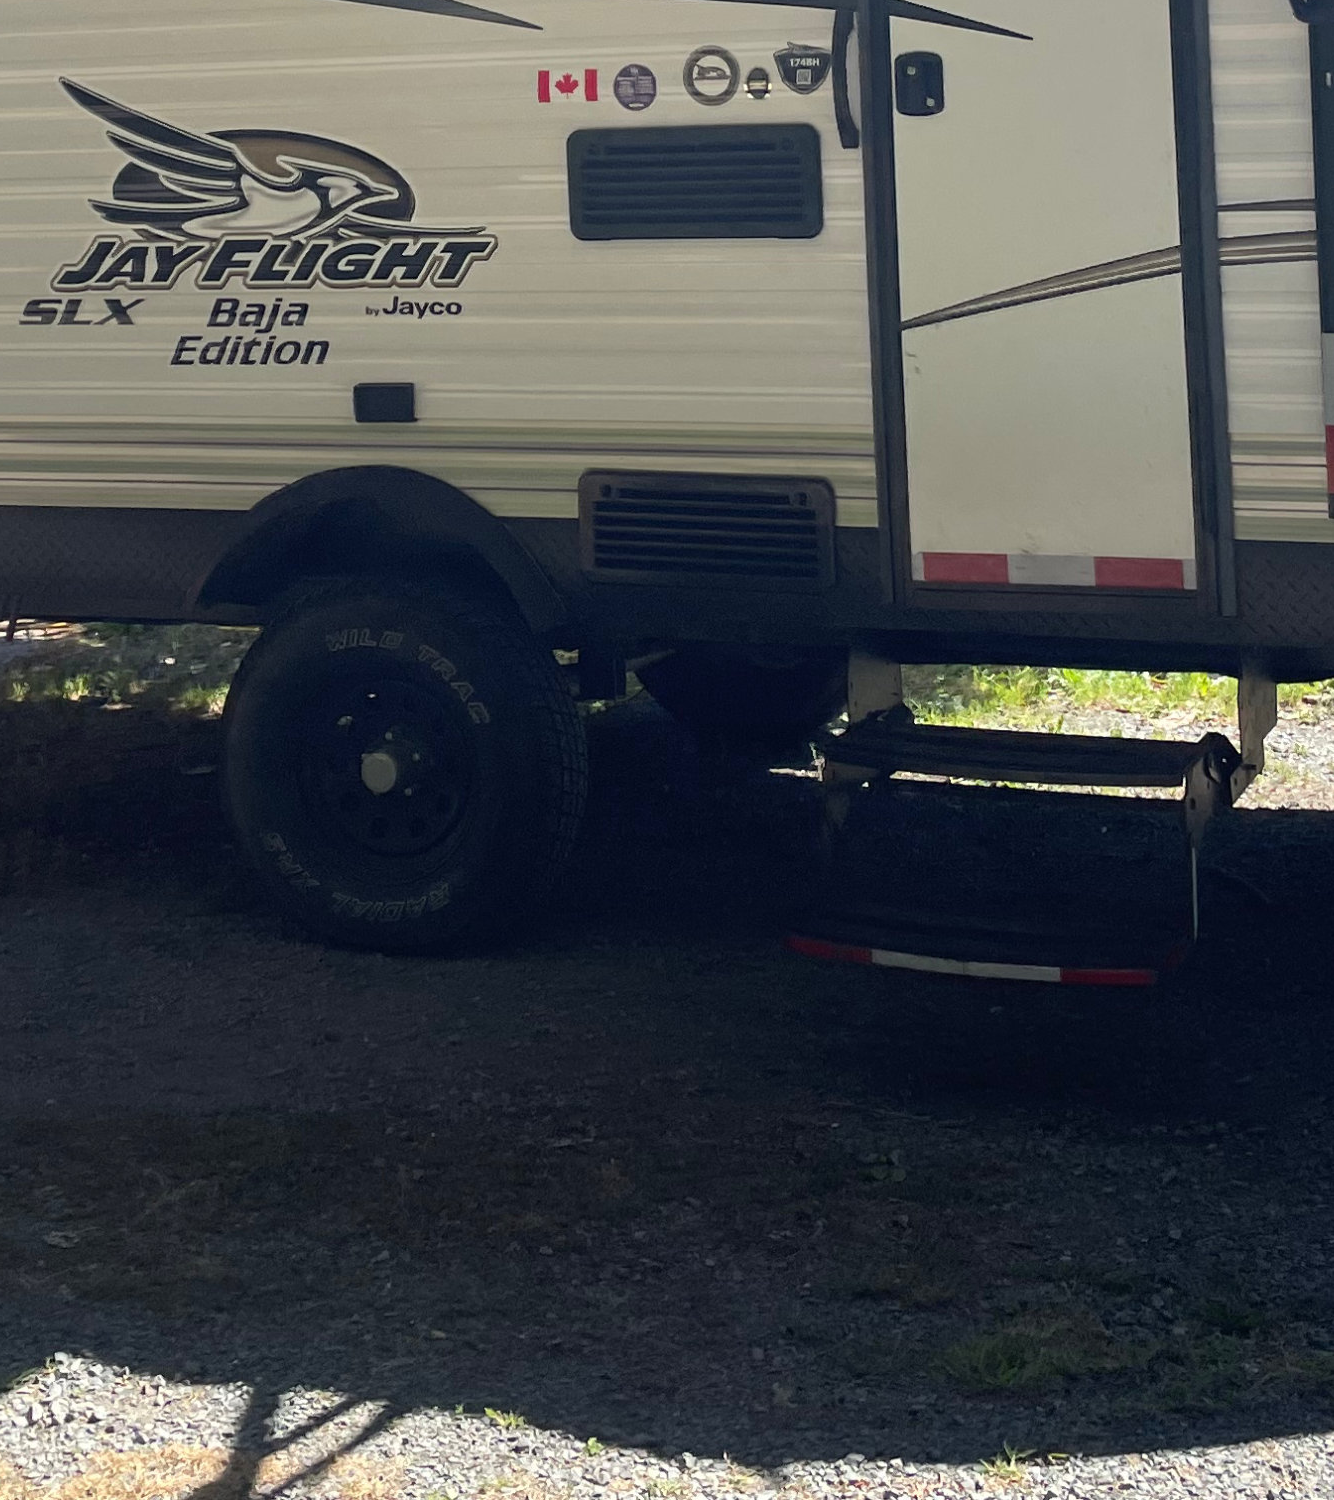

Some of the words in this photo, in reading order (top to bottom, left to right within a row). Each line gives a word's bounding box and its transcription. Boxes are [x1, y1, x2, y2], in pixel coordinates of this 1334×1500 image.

[789, 57, 820, 68] 174BH
[18, 297, 148, 326] SLX
[206, 296, 310, 334] Baja
[365, 306, 381, 319] by
[382, 296, 463, 319] Jayco
[170, 335, 330, 366] Edition
[325, 627, 405, 652] WILD
[419, 643, 491, 725] TRAC
